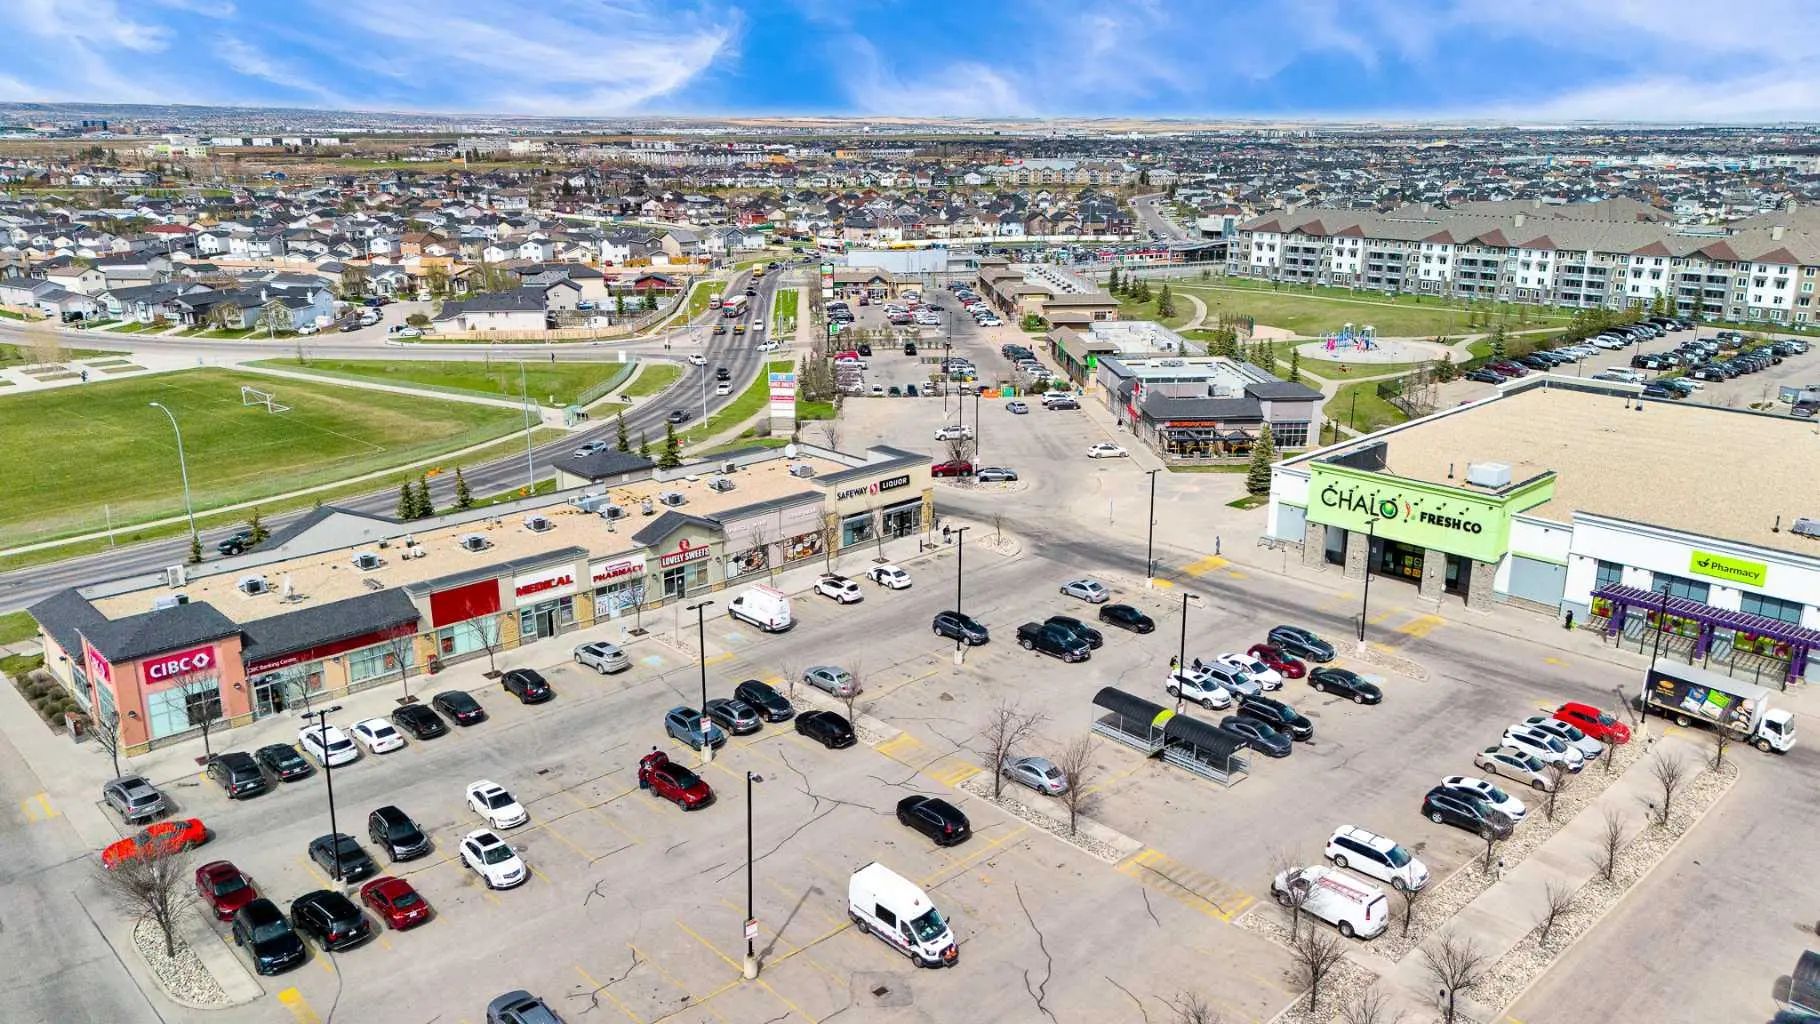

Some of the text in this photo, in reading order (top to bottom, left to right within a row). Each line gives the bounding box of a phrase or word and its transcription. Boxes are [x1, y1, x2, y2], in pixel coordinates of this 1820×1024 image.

[837, 477, 907, 501] SAFEWAY LIQUOR
[662, 547, 710, 566] LOVELY SWEETS
[592, 563, 644, 583] PHARMACY
[1711, 561, 1761, 580] Pharmacy
[515, 574, 574, 598] MEDICAL
[149, 657, 192, 678] CIBC
